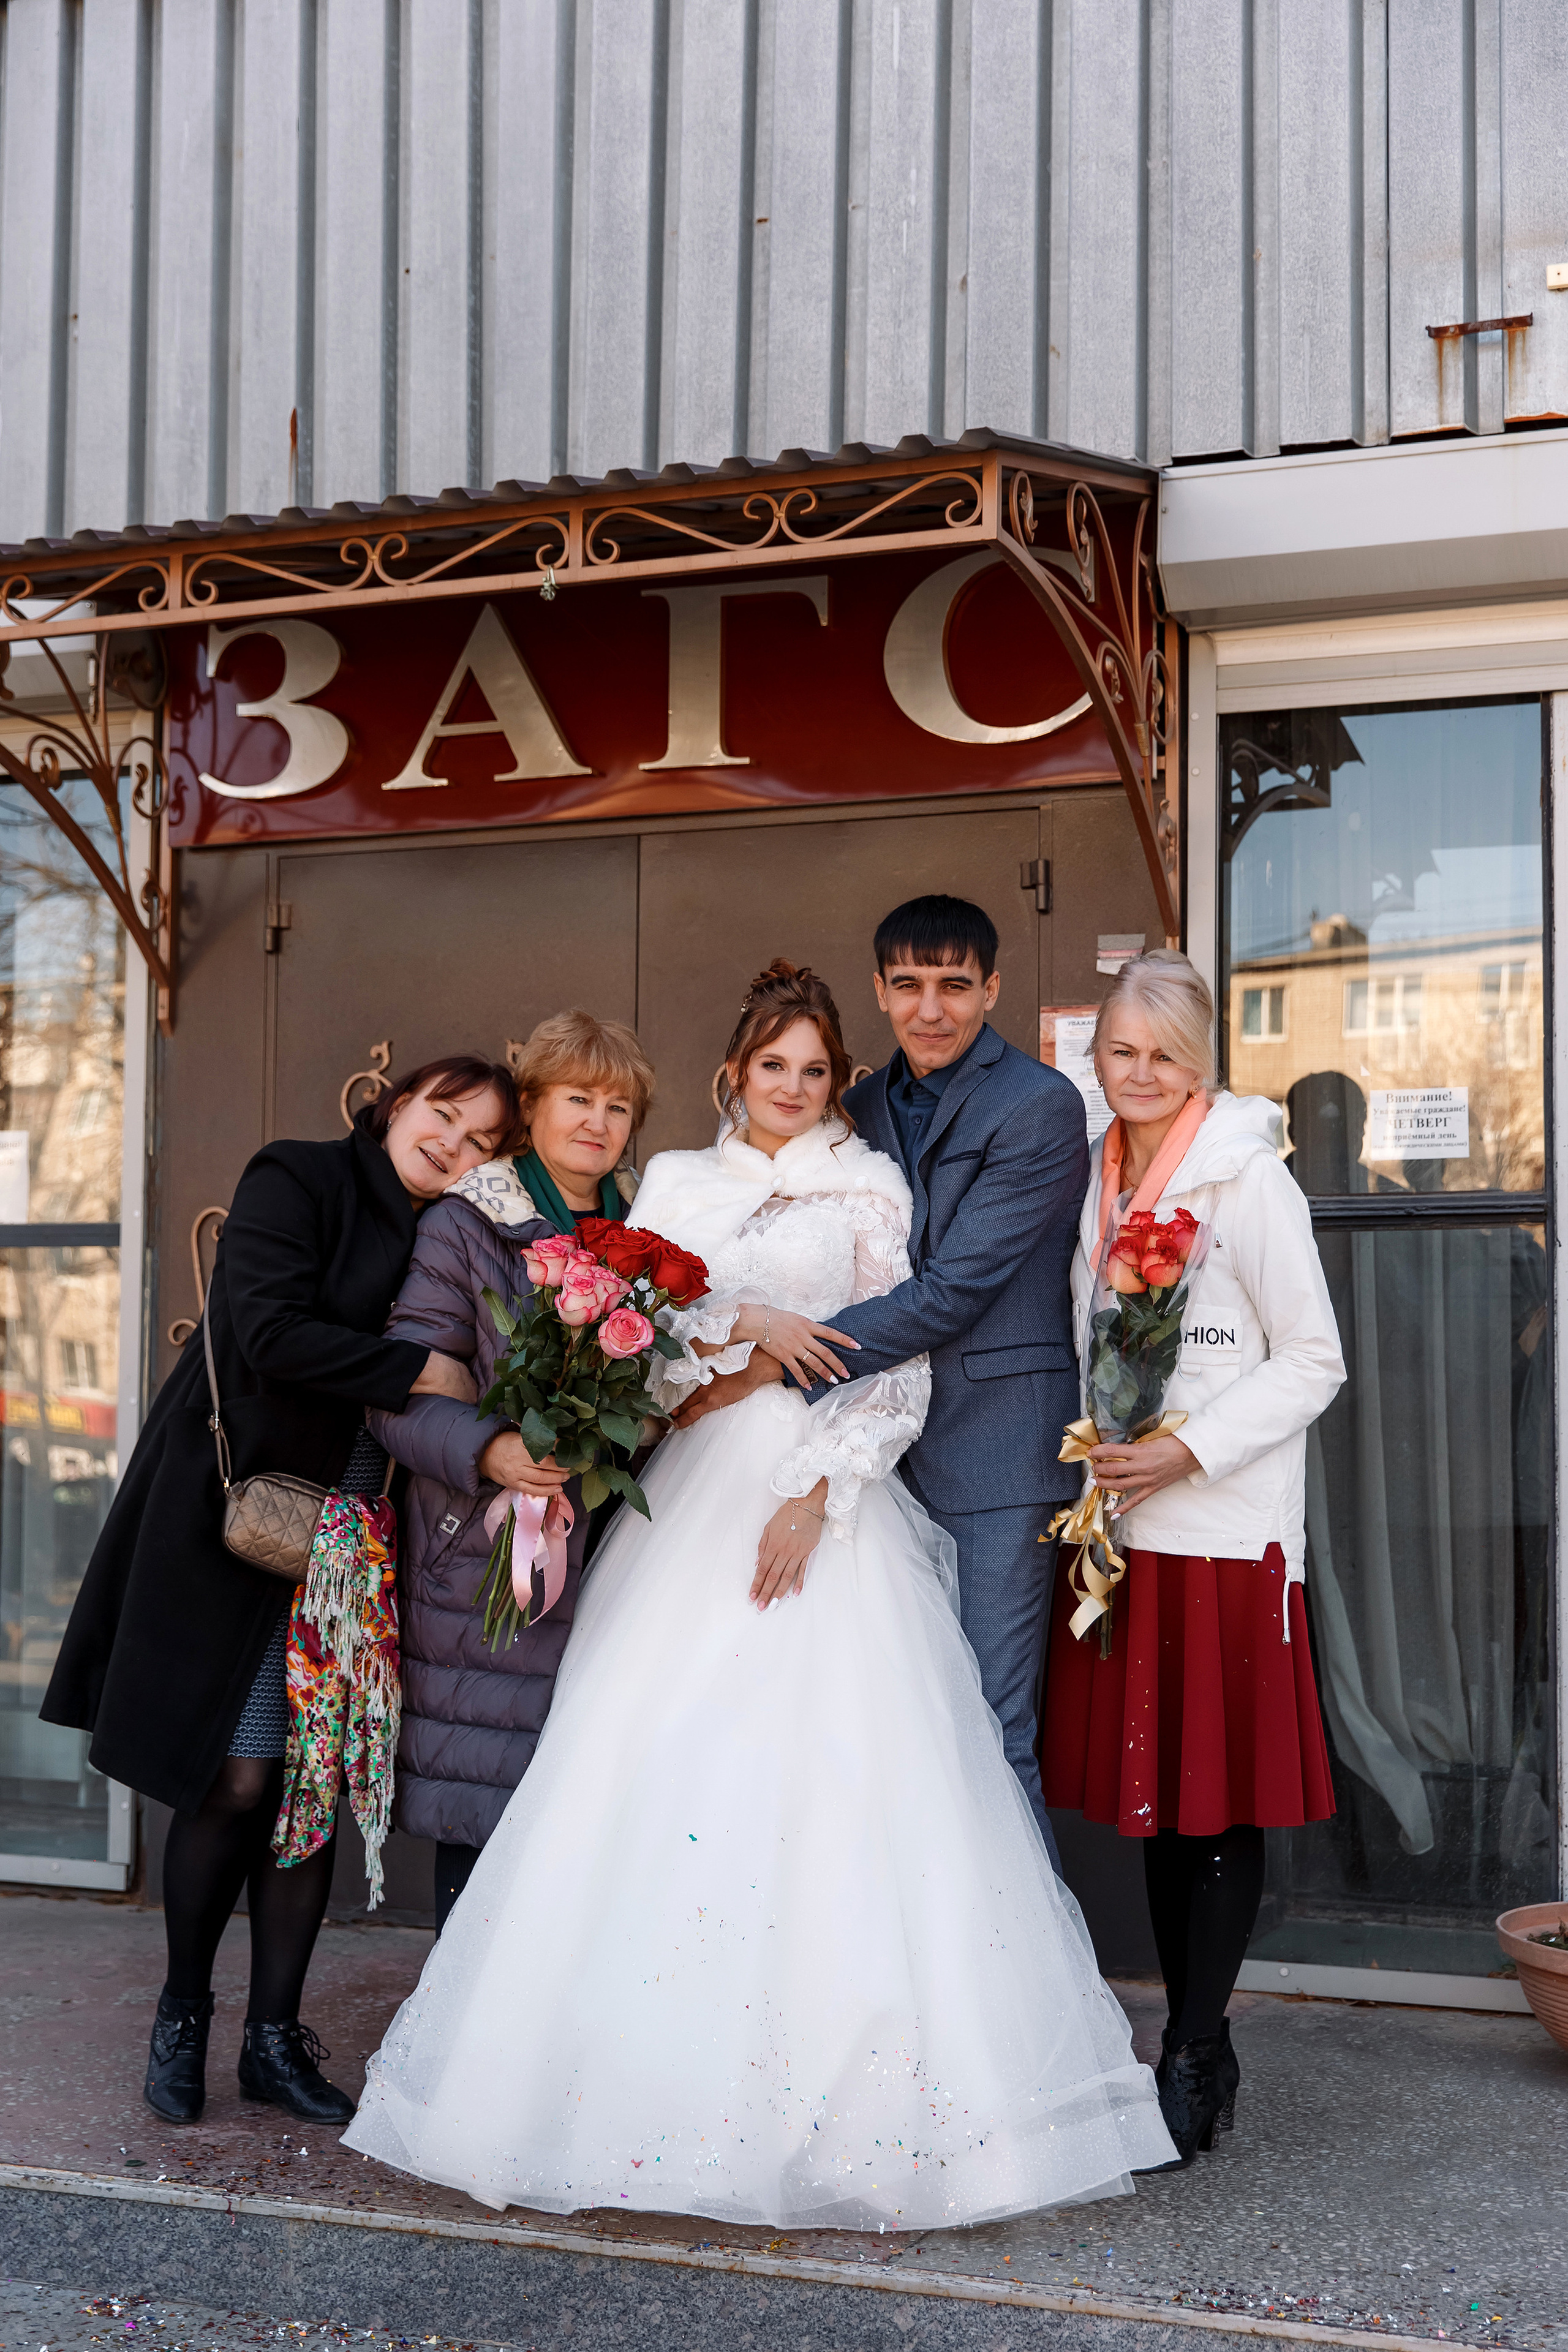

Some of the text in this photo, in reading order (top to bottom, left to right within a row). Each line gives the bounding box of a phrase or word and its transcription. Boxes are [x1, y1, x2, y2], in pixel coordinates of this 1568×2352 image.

[198, 537, 1096, 799] ЗАГС
[1386, 1091, 1452, 1103] Внимание!
[1423, 1105, 1466, 1115] граждане!
[1388, 1117, 1452, 1129] ЧЕТВЕРГ
[1383, 1133, 1436, 1142] нприёмный
